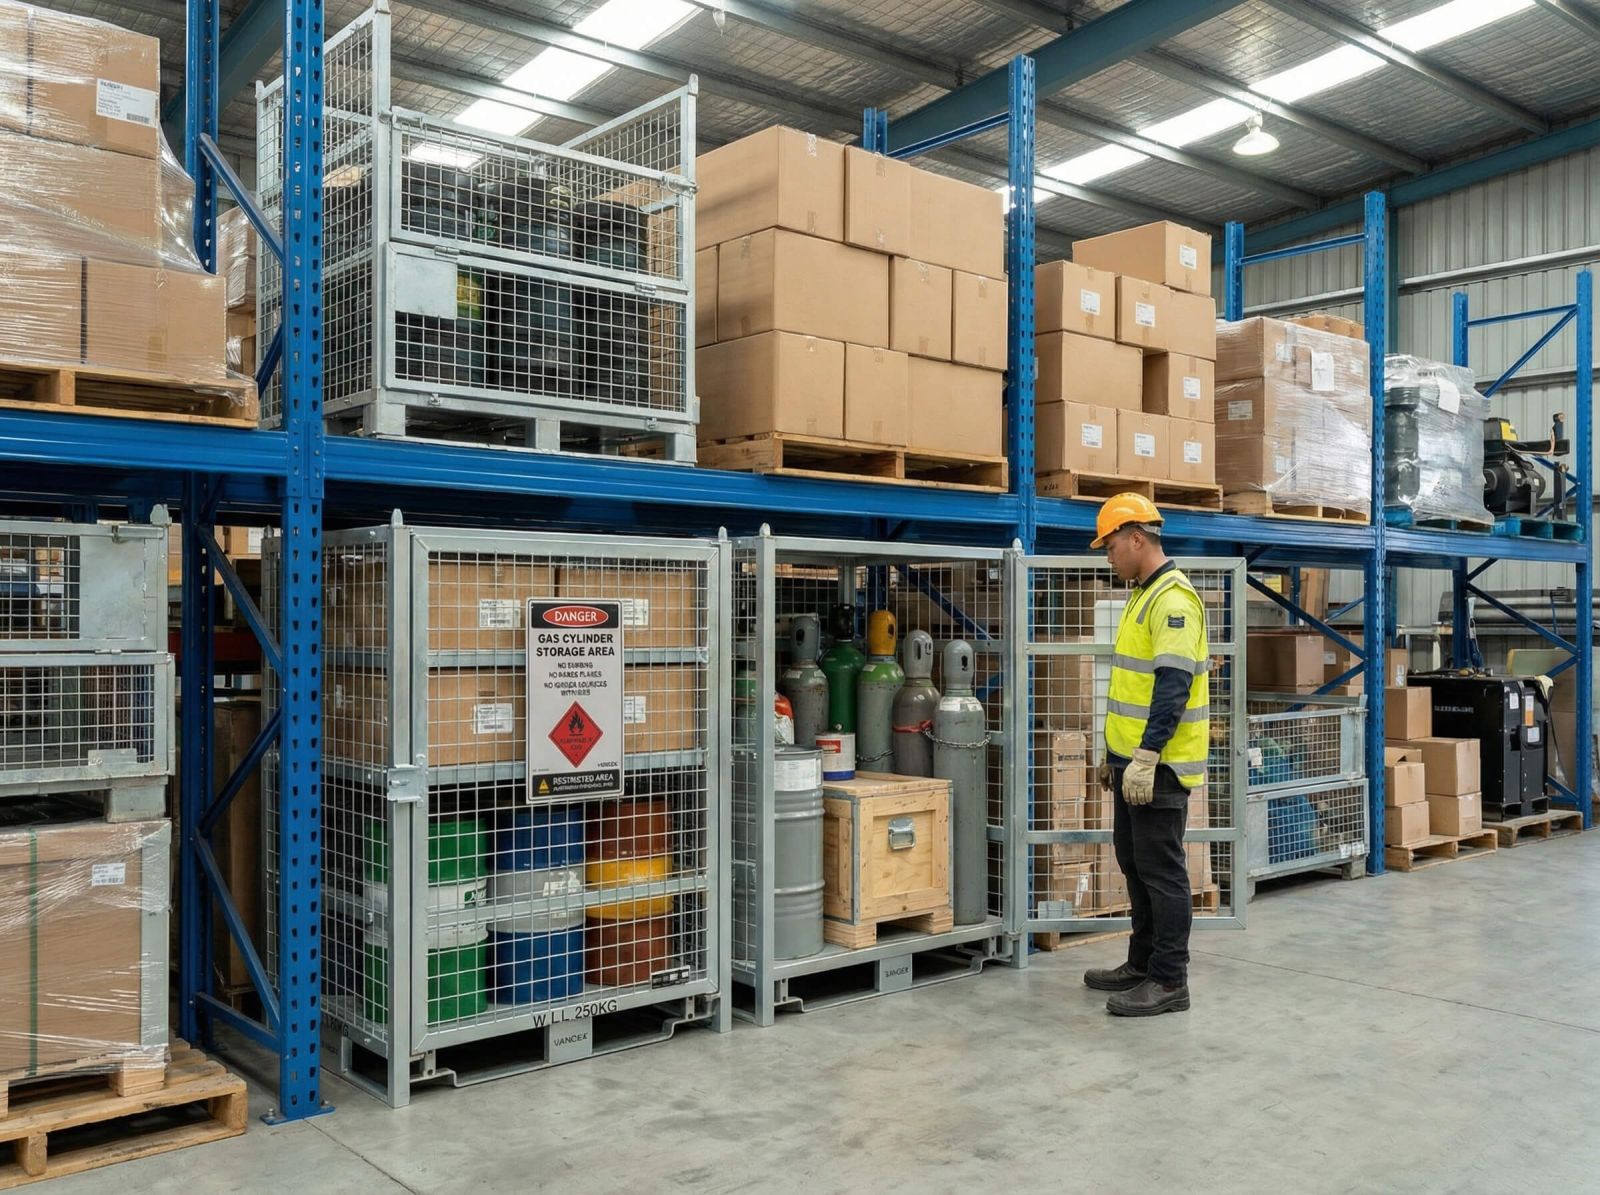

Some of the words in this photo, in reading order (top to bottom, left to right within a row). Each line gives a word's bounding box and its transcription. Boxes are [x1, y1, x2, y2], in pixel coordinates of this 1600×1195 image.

[554, 610, 597, 622] DANGER
[538, 633, 560, 644] GAS
[562, 633, 613, 644] CYLINDER
[536, 647, 585, 657] STORAGE
[588, 646, 615, 656] AREA
[575, 1000, 617, 1019] 250KG
